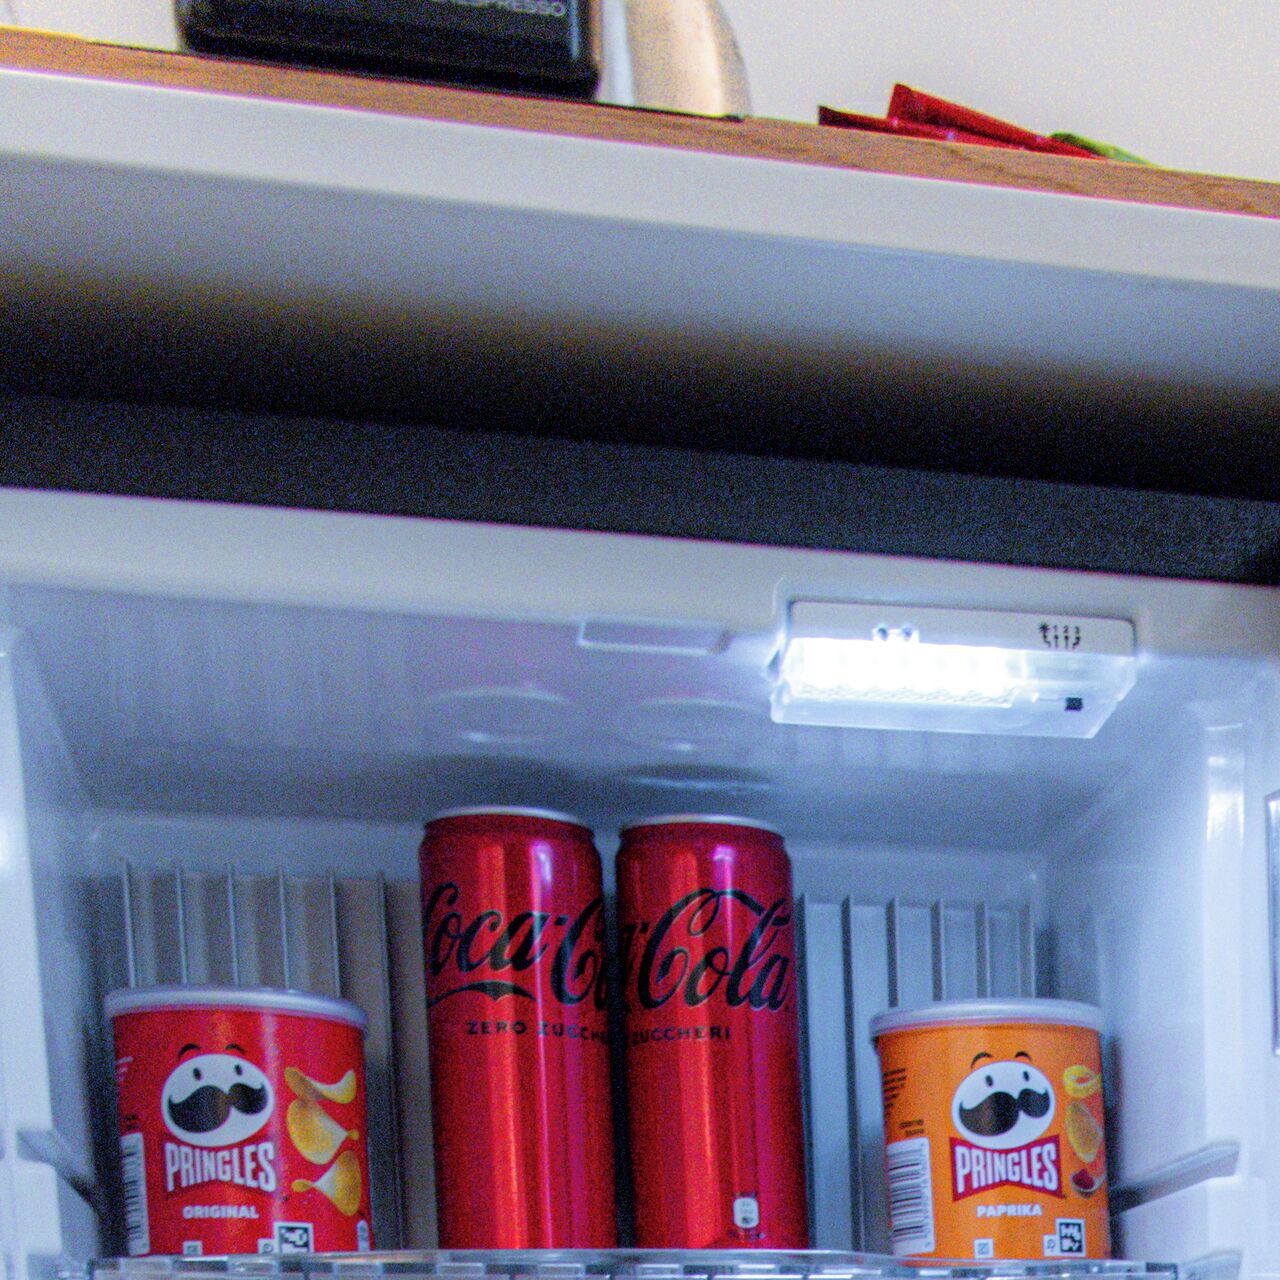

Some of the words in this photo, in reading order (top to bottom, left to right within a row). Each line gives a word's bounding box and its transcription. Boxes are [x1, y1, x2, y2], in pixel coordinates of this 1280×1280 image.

[467, 1021, 528, 1036] ZERO
[165, 1141, 276, 1193] PRINGLES
[954, 1143, 1060, 1194] PRINGLES
[182, 1204, 260, 1220] ORIGINAL
[976, 1204, 1043, 1218] PAPRIKA
